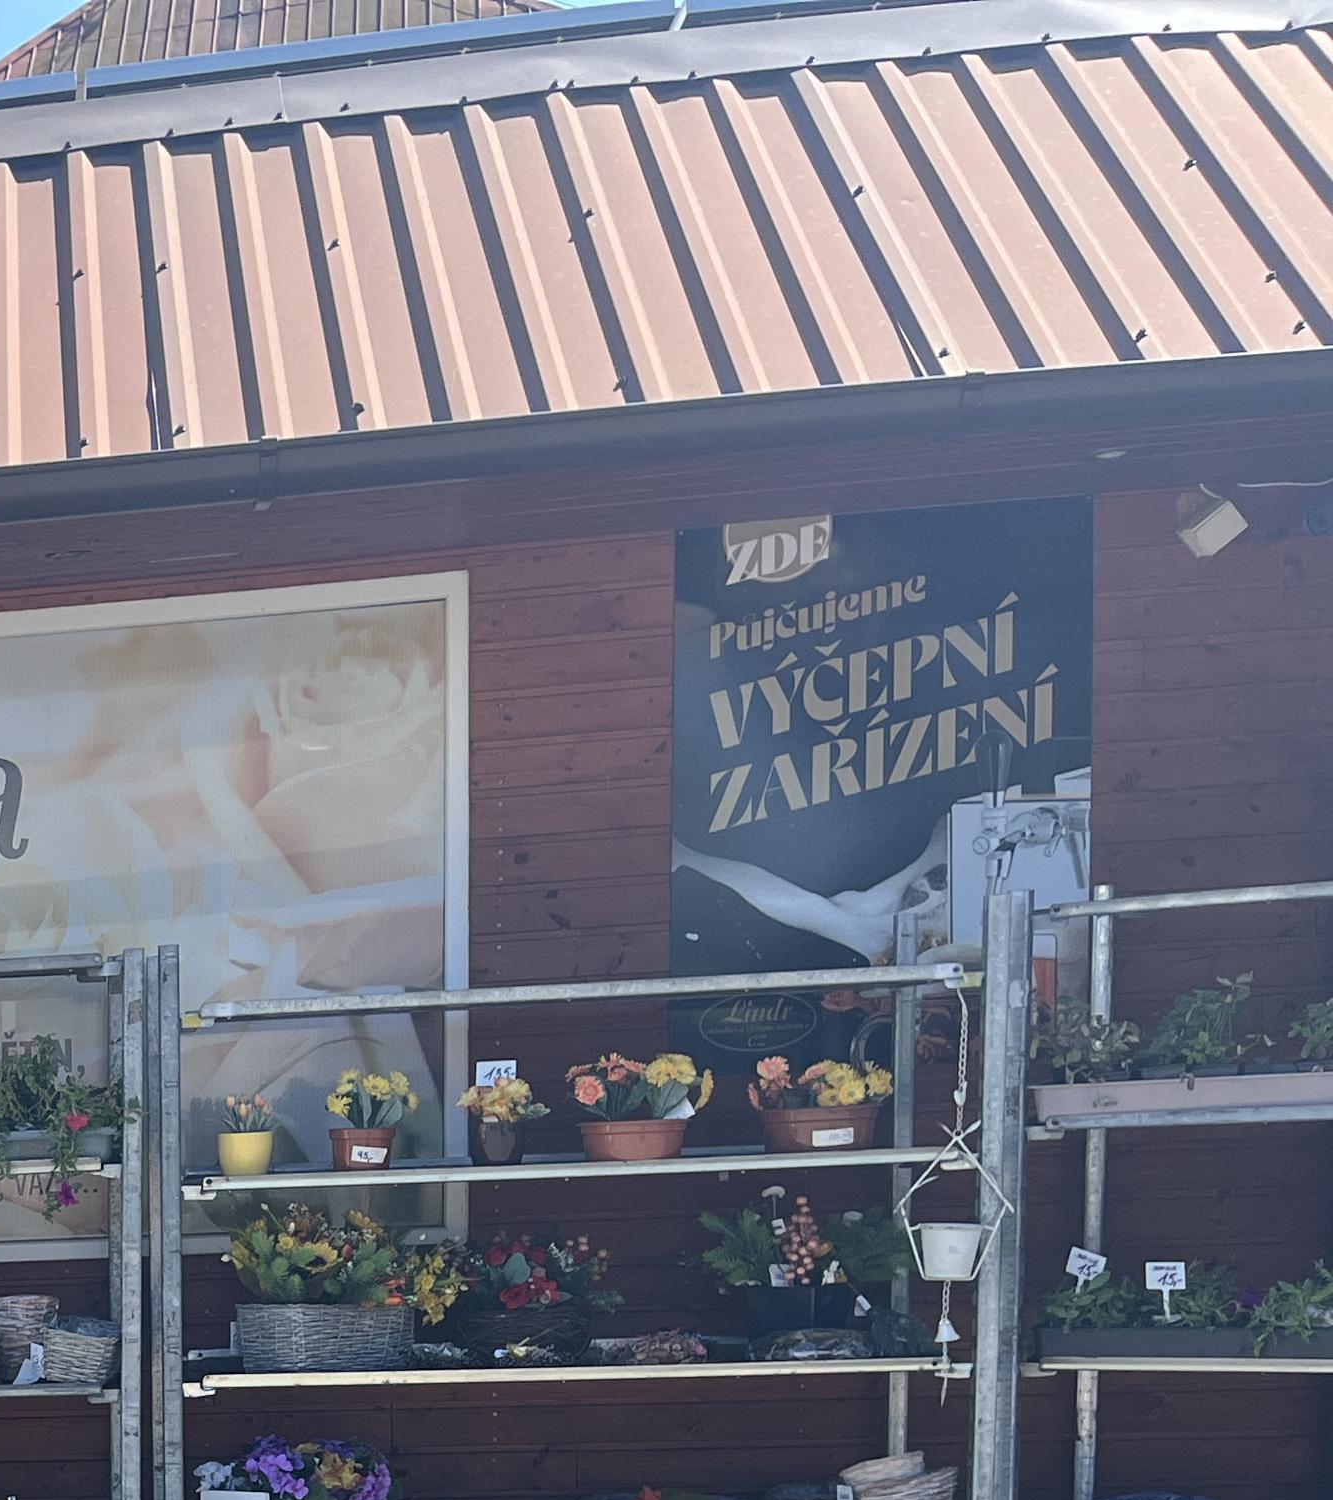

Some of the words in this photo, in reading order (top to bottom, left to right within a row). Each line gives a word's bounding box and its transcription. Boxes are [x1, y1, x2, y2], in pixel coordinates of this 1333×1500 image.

[725, 520, 830, 586] ZDE
[708, 662, 1060, 833] ZAŘÍZENÍ
[709, 591, 1020, 749] VÝČEPNÍ
